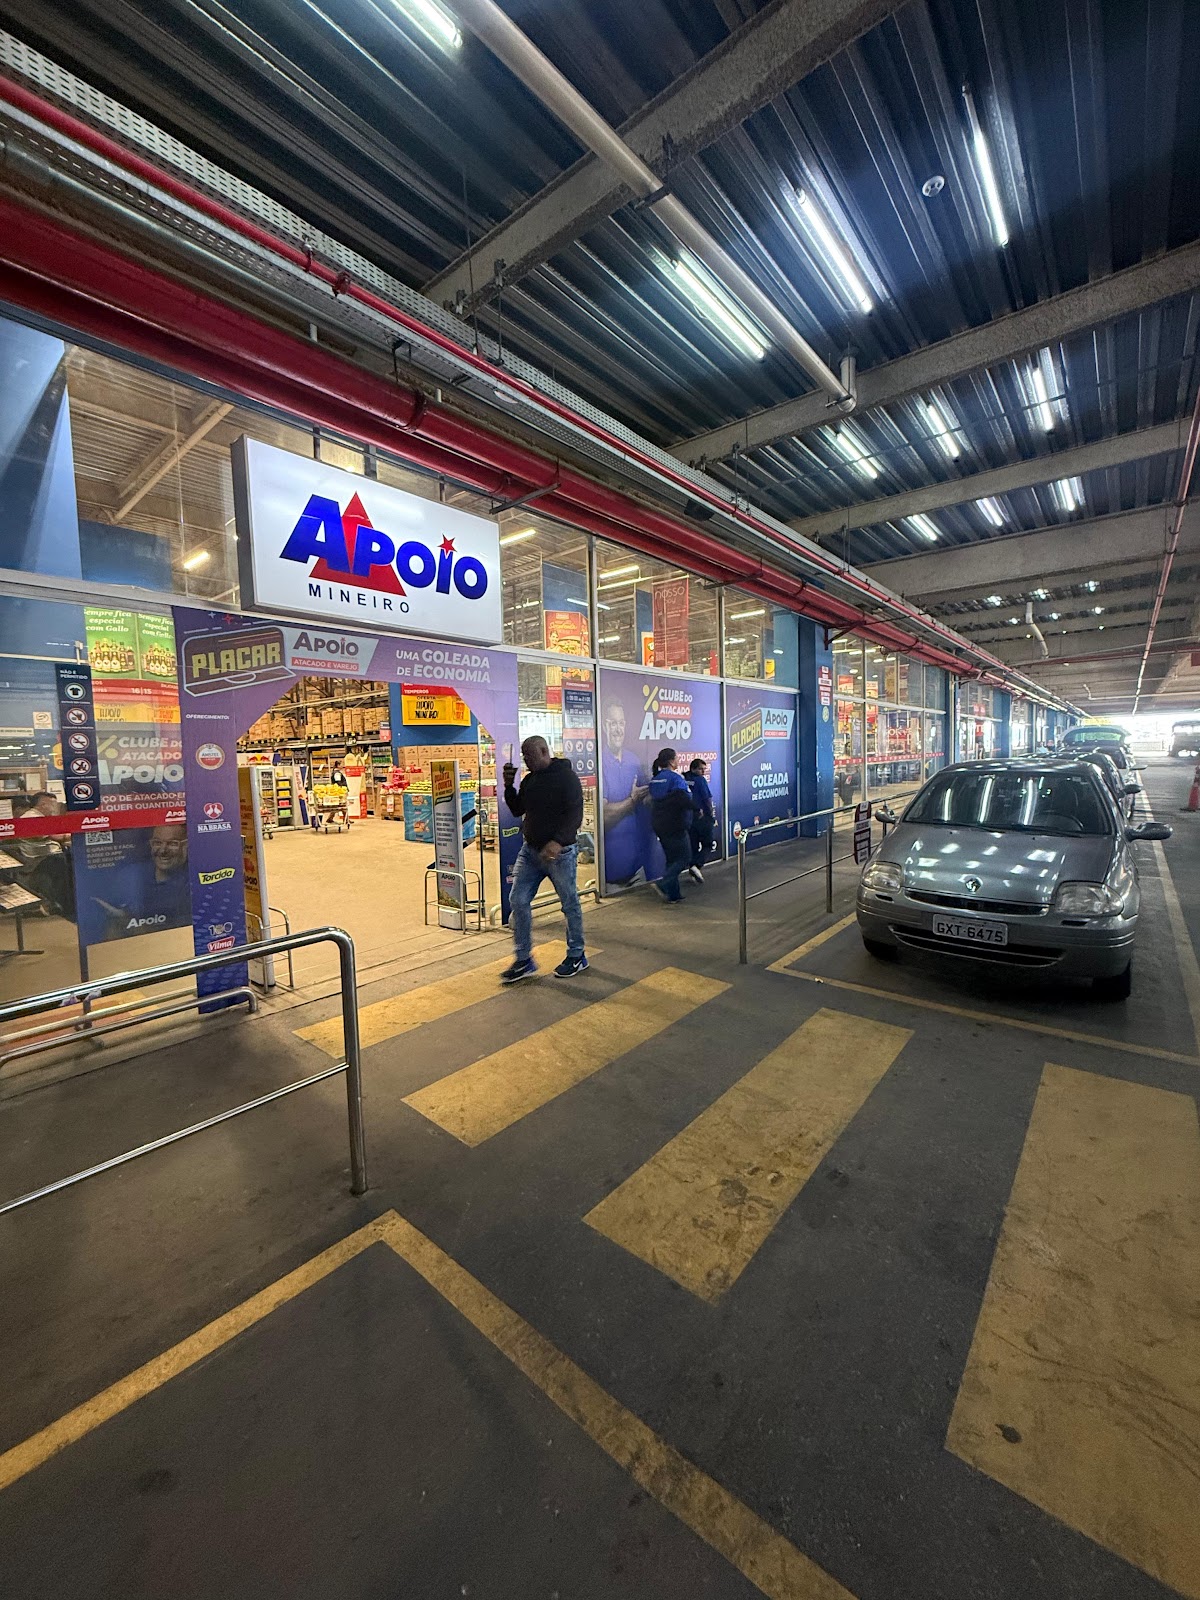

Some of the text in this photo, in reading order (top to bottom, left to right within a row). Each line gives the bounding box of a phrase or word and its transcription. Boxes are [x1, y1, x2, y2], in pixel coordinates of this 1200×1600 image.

[308, 583, 410, 614] MINEIRO
[89, 617, 125, 625] especial
[191, 642, 281, 678] PLACAR
[294, 659, 326, 668] ATACADO
[396, 649, 490, 669] UMA GOLEADA
[396, 664, 491, 683] DE ECONOMIA
[658, 689, 693, 703] CLUBE DO
[660, 706, 690, 716] ATACADO
[639, 712, 692, 740] APOIO
[119, 737, 169, 748] CLUBE
[731, 720, 762, 753] PLACAR
[122, 751, 182, 761] ATACADO
[761, 763, 772, 771] UMA
[752, 772, 789, 788] GOLEADA
[134, 793, 175, 801] ATACADO
[758, 787, 789, 800] ECONOMIA
[135, 800, 186, 809] QUANTIDAD
[202, 870, 232, 882] Torcida
[209, 941, 233, 950] Vilma
